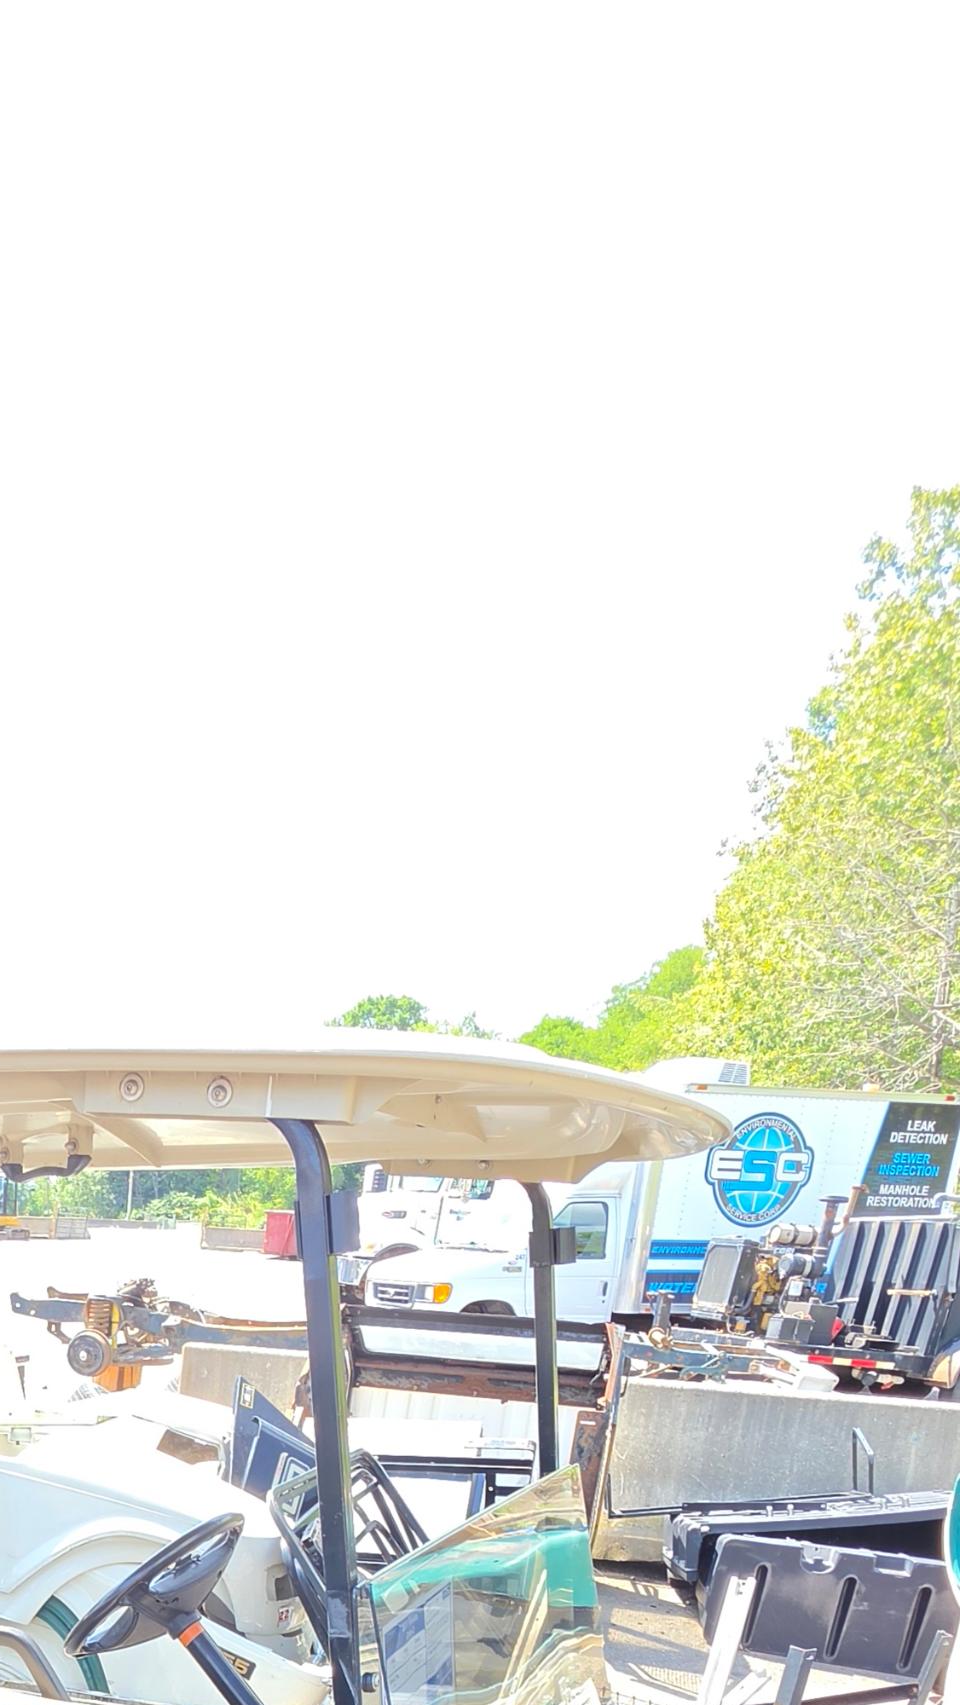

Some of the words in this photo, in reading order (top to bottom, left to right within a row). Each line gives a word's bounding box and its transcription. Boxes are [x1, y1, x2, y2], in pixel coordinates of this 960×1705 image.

[736, 1118, 797, 1140] ENVIRONMENTAL
[907, 1119, 937, 1132] LEAK
[889, 1131, 949, 1145] DETECTION
[893, 1152, 931, 1164] SEWER
[710, 1149, 810, 1192] ESC
[877, 1163, 940, 1177] INSPECTION
[878, 1184, 930, 1196] MANHOLE
[866, 1196, 938, 1209] RESTORATION
